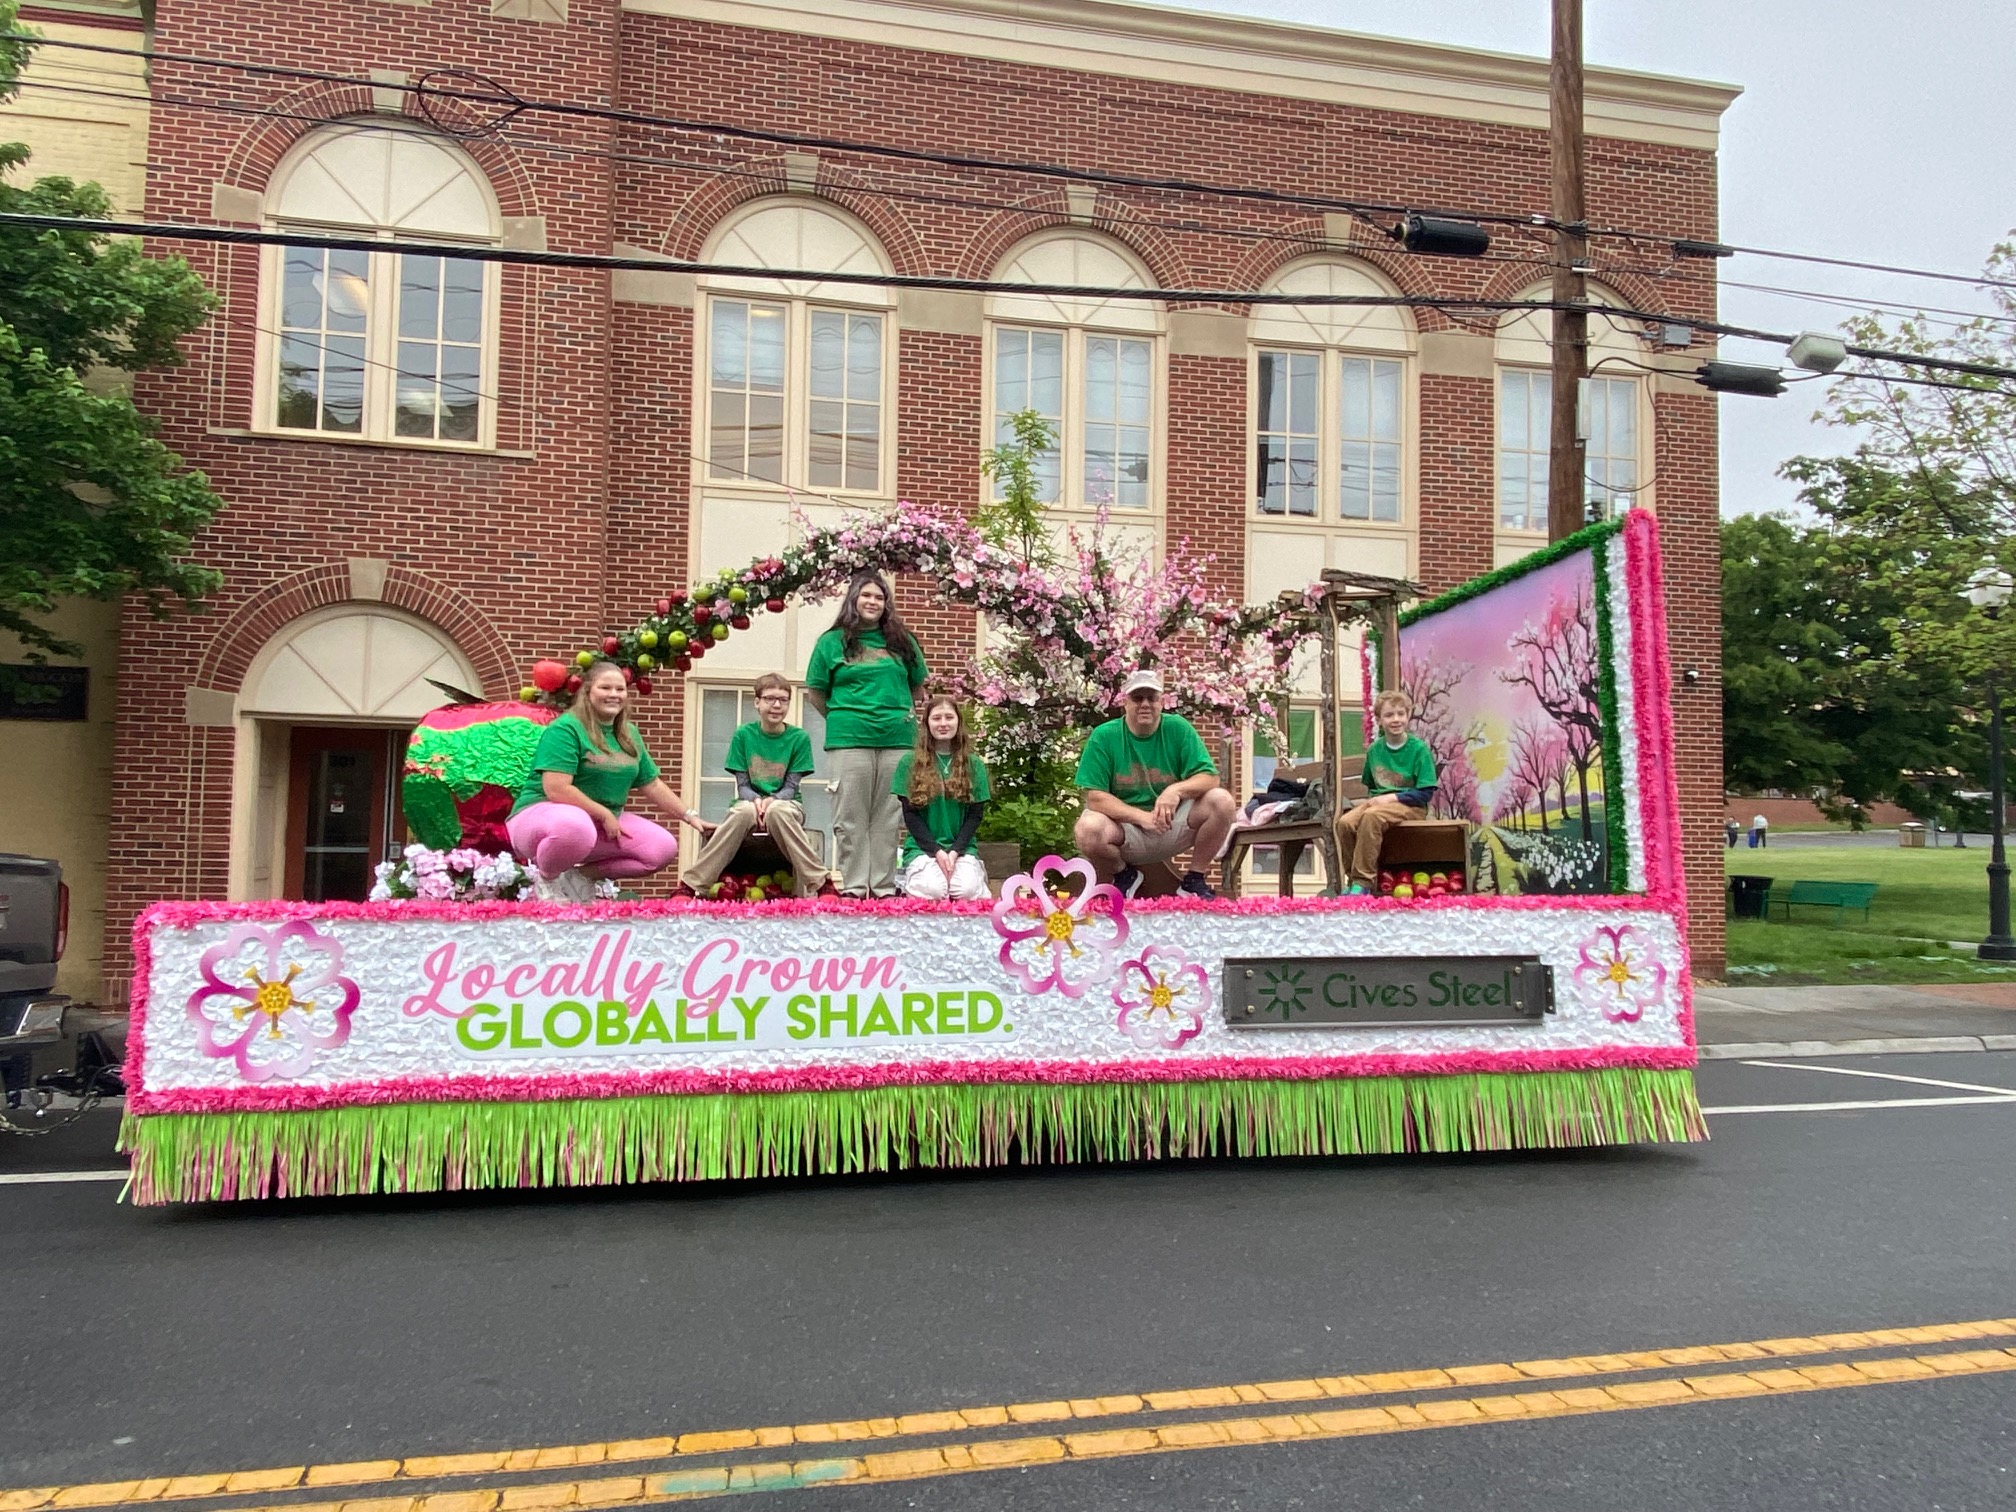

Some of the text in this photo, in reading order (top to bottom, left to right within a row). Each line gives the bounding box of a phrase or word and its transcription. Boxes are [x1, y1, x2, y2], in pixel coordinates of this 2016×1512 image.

[402, 929, 907, 1019] Locally Grown.
[1322, 970, 1512, 1009] Cives Steel
[456, 990, 1013, 1051] GLOBALLY SHARED.
